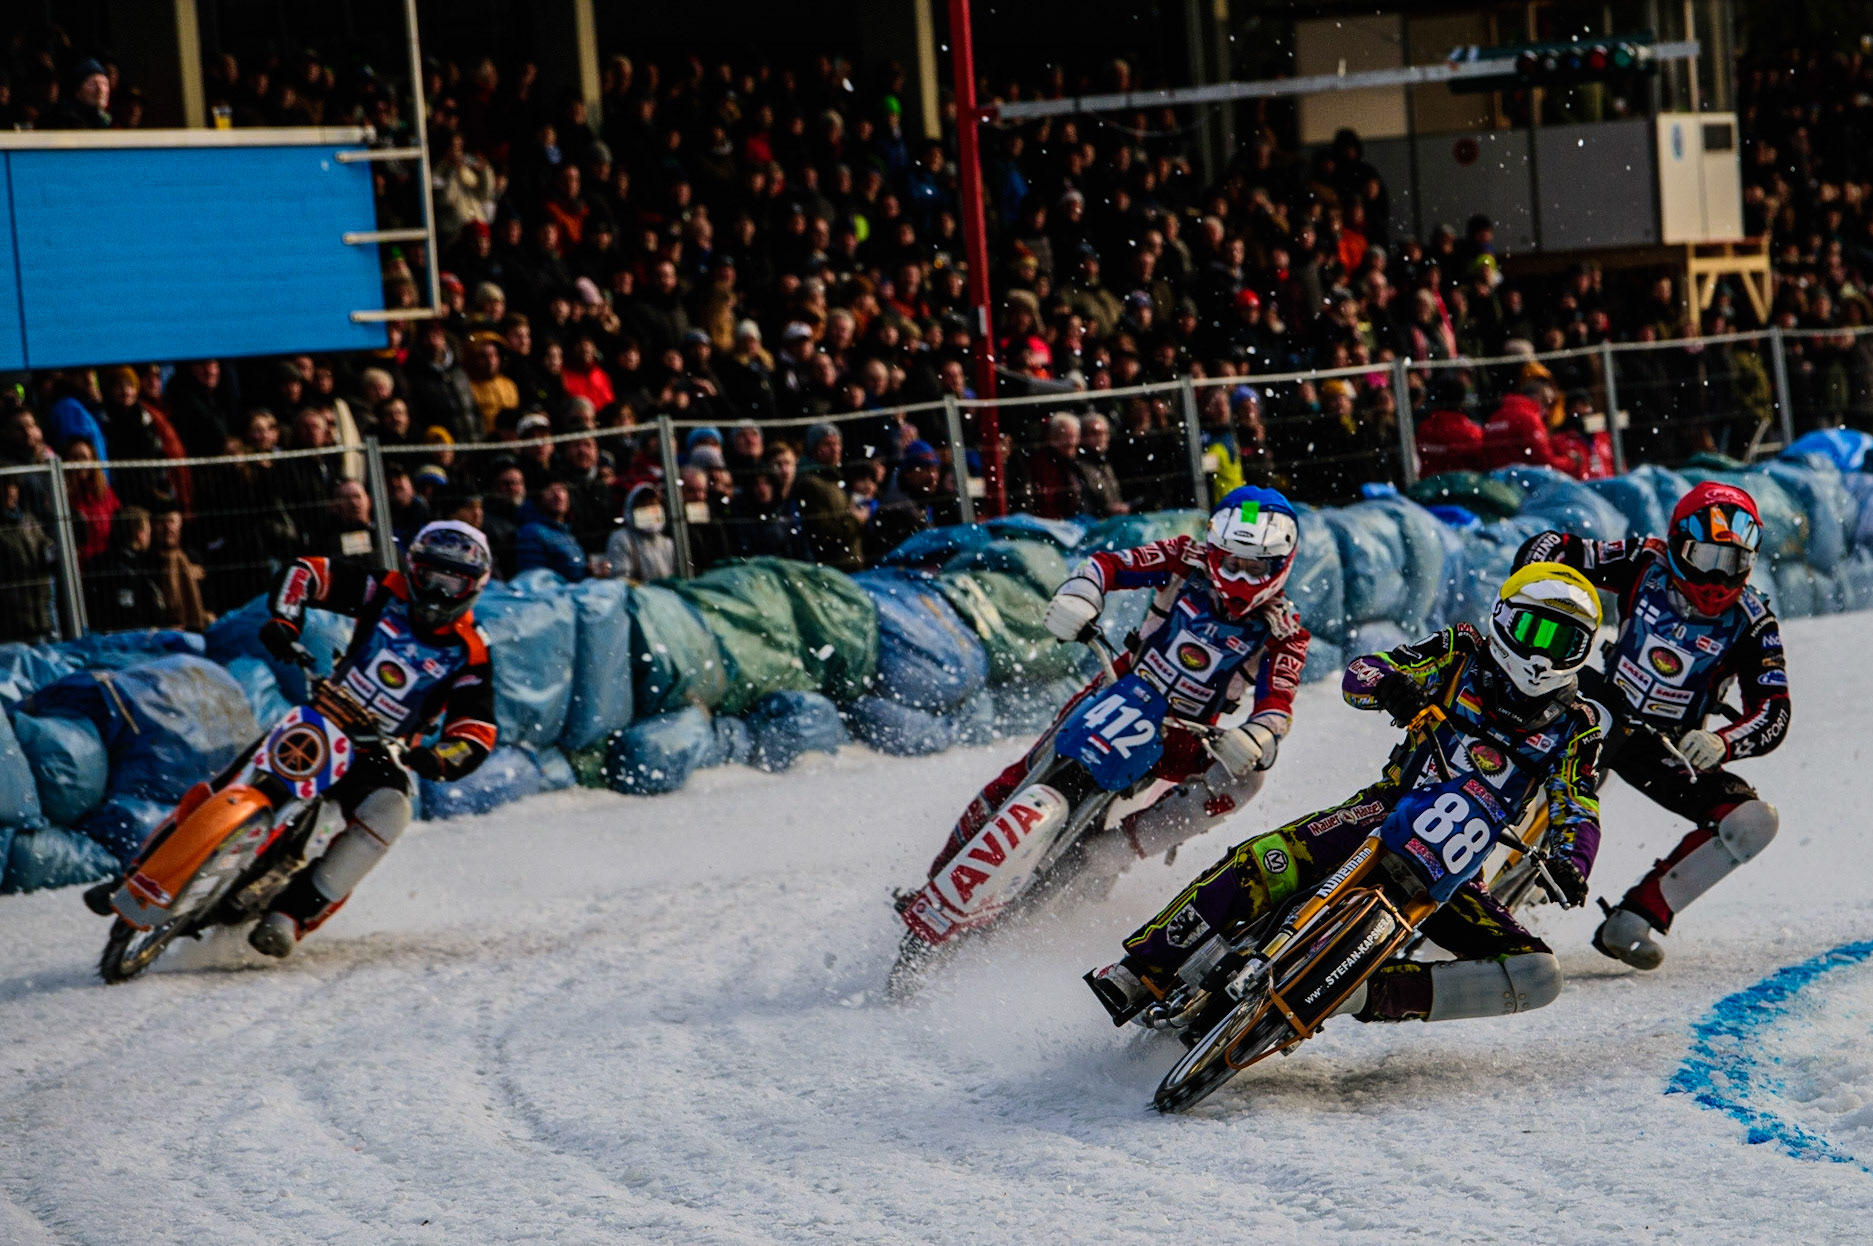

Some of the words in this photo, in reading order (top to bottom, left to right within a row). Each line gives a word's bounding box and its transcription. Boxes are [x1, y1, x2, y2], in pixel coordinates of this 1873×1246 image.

[1083, 694, 1156, 759] 412
[949, 804, 1045, 905] AVIA
[1308, 814, 1340, 836] Mauer
[1413, 792, 1490, 874] 88
